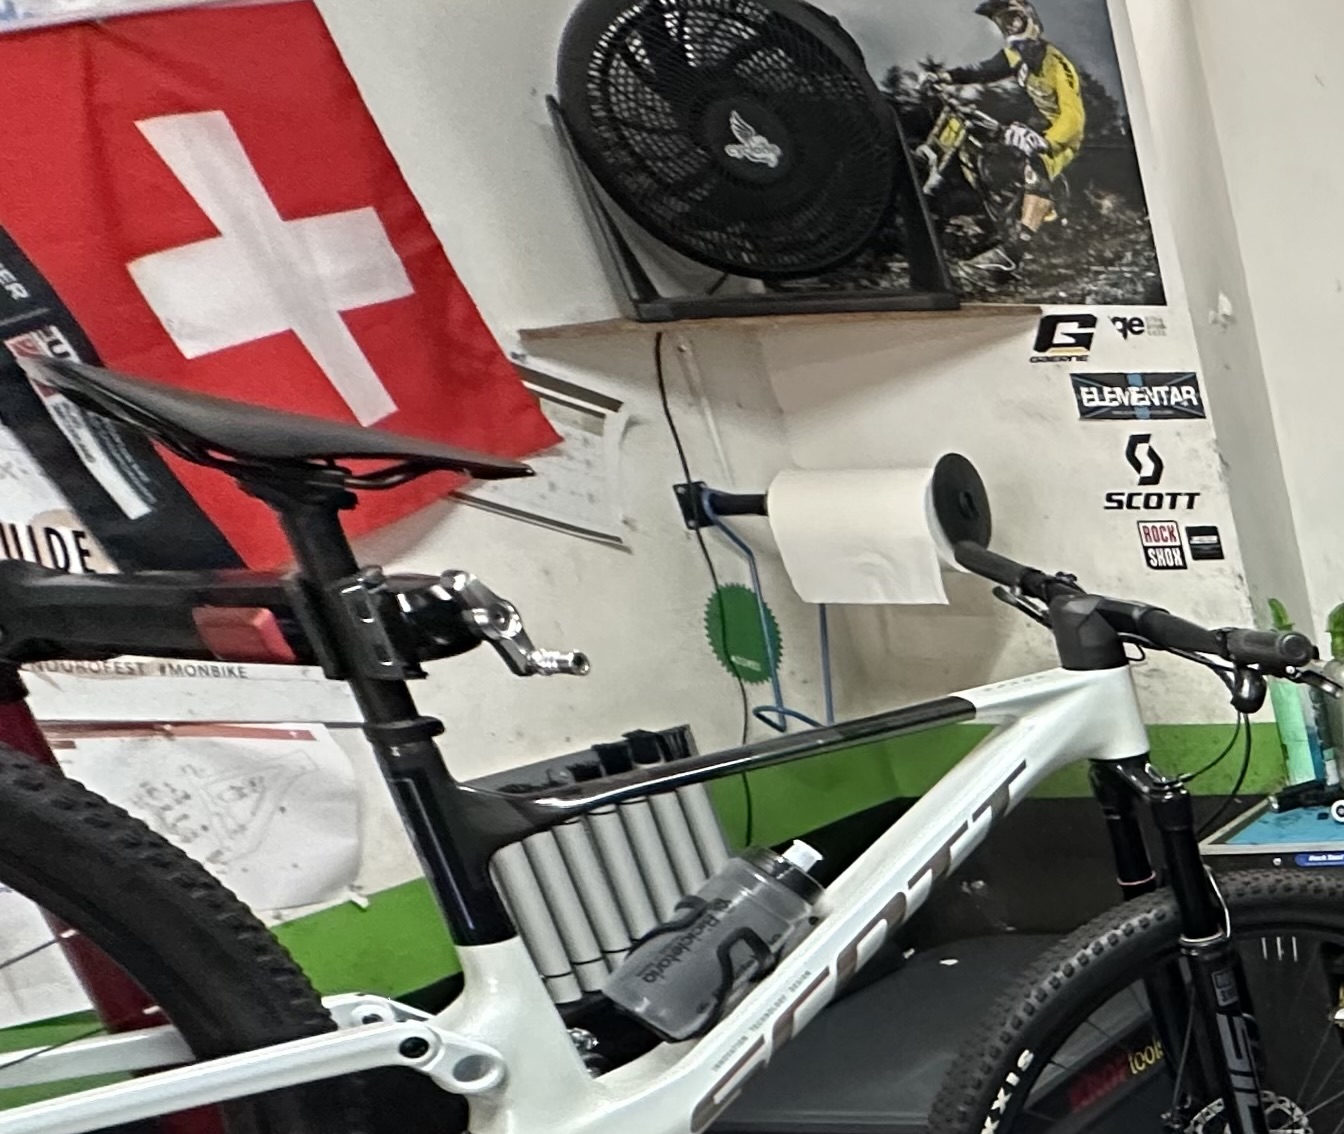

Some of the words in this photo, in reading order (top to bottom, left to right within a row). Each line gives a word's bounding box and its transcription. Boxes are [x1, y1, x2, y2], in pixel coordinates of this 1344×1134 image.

[1079, 385, 1199, 408] ELEMENTAR
[1103, 492, 1201, 510] SCOTT
[1141, 524, 1178, 543] ROCK
[1148, 547, 1183, 568] SHOX
